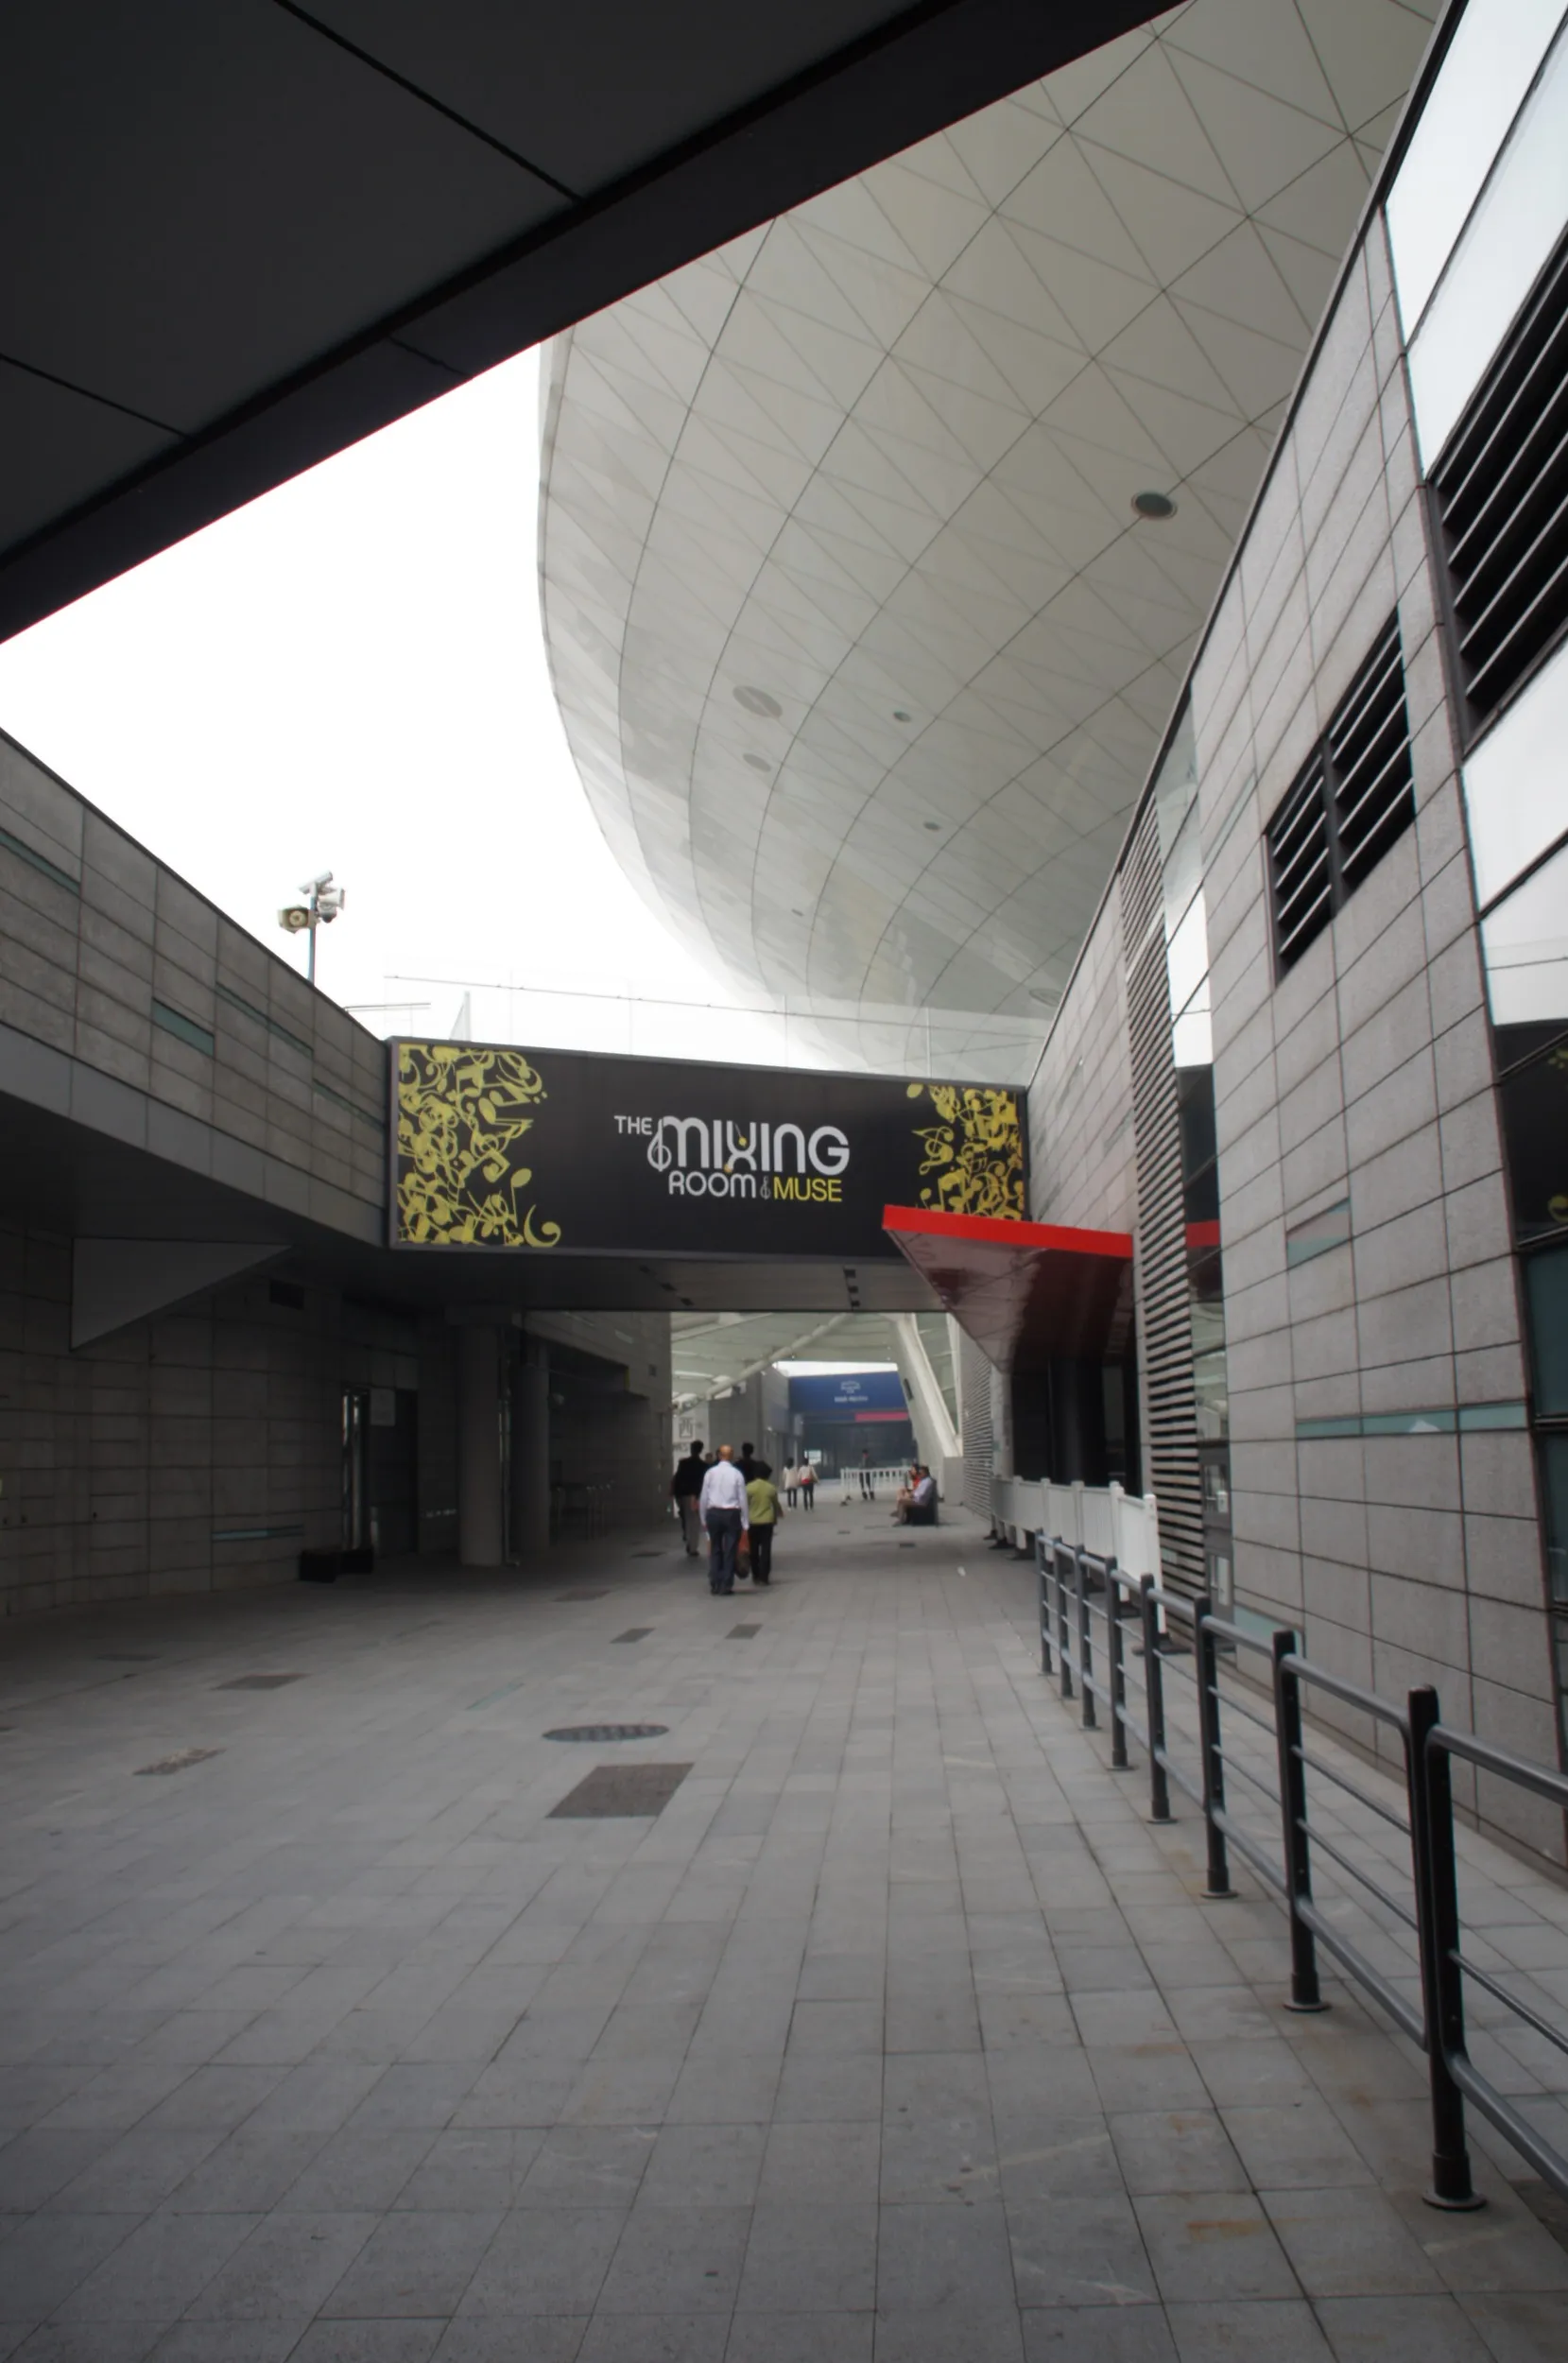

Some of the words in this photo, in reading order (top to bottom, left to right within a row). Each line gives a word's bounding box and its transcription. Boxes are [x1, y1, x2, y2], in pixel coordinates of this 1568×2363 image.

[614, 1115, 653, 1135] THE
[647, 1115, 850, 1176] MIXING
[668, 1170, 756, 1199] ROOM
[773, 1177, 842, 1202] MUSE
